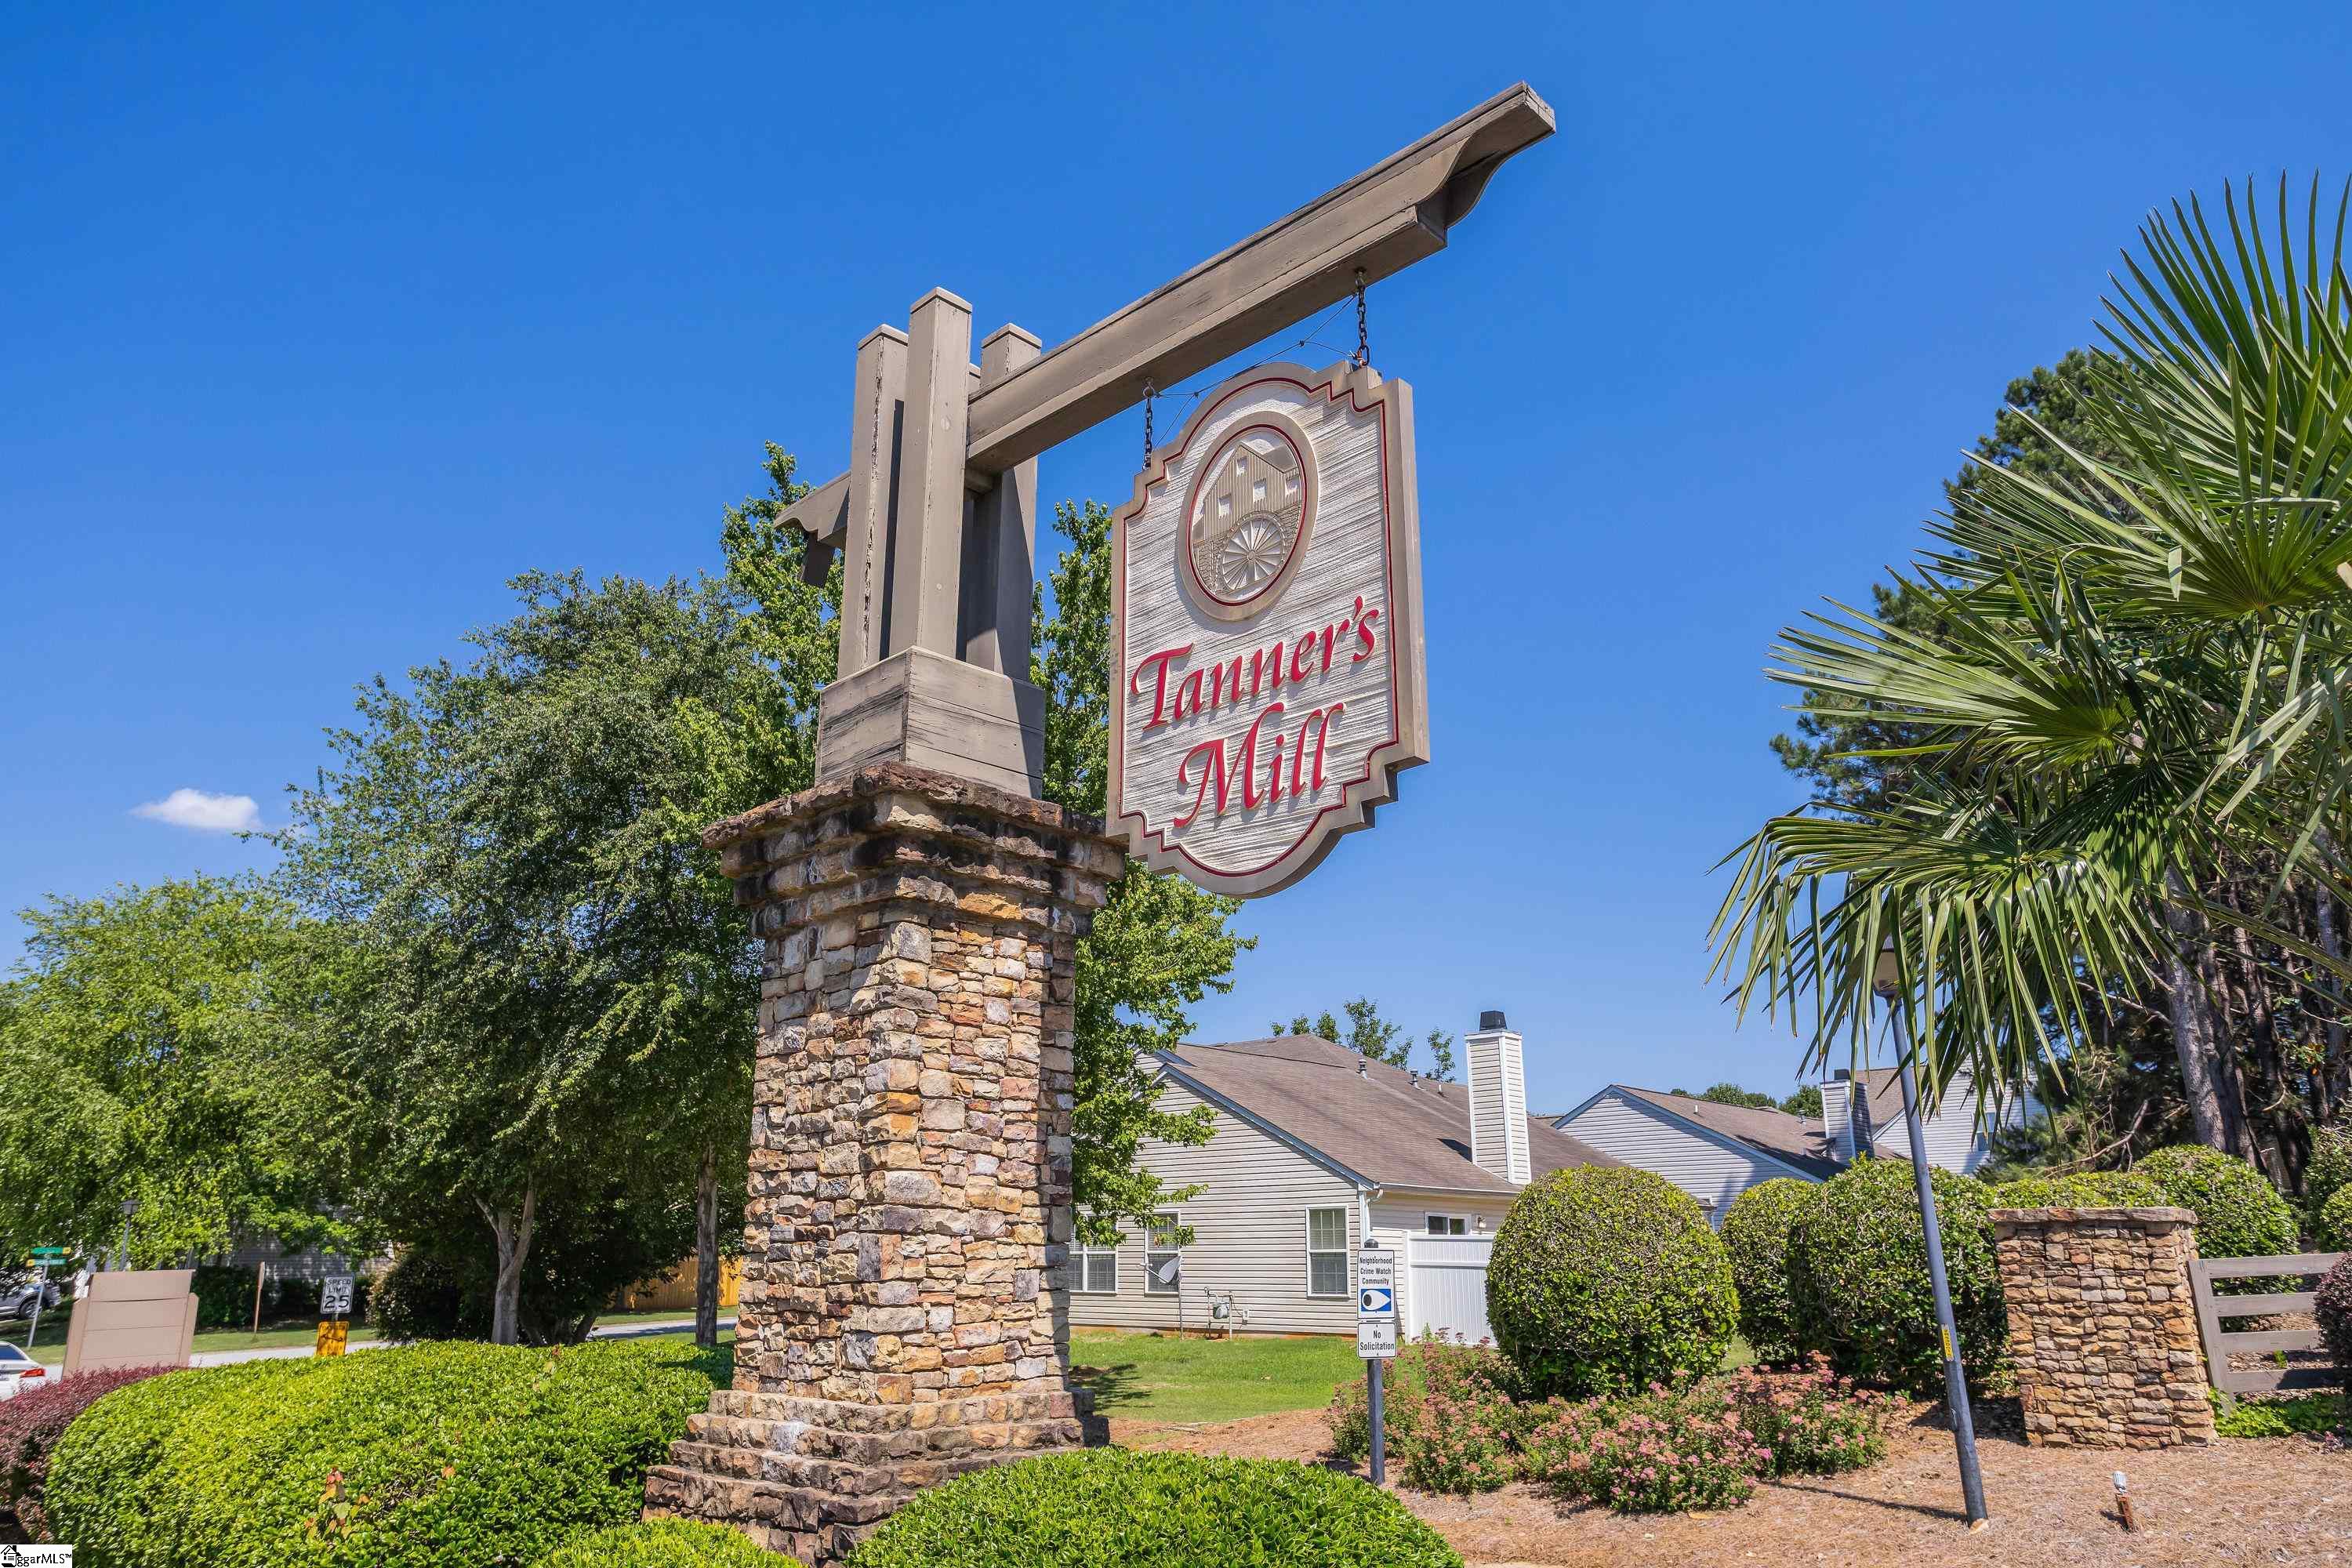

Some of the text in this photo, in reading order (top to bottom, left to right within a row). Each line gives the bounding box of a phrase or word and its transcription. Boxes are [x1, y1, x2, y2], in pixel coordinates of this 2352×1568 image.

[1130, 595, 1380, 731] Tanner's
[1173, 702, 1346, 829] Mill
[1359, 1257, 1392, 1265] Neighborhood
[324, 1295, 350, 1308] 25
[1373, 1330, 1381, 1339] No
[1359, 1341, 1395, 1351] Solicitation
